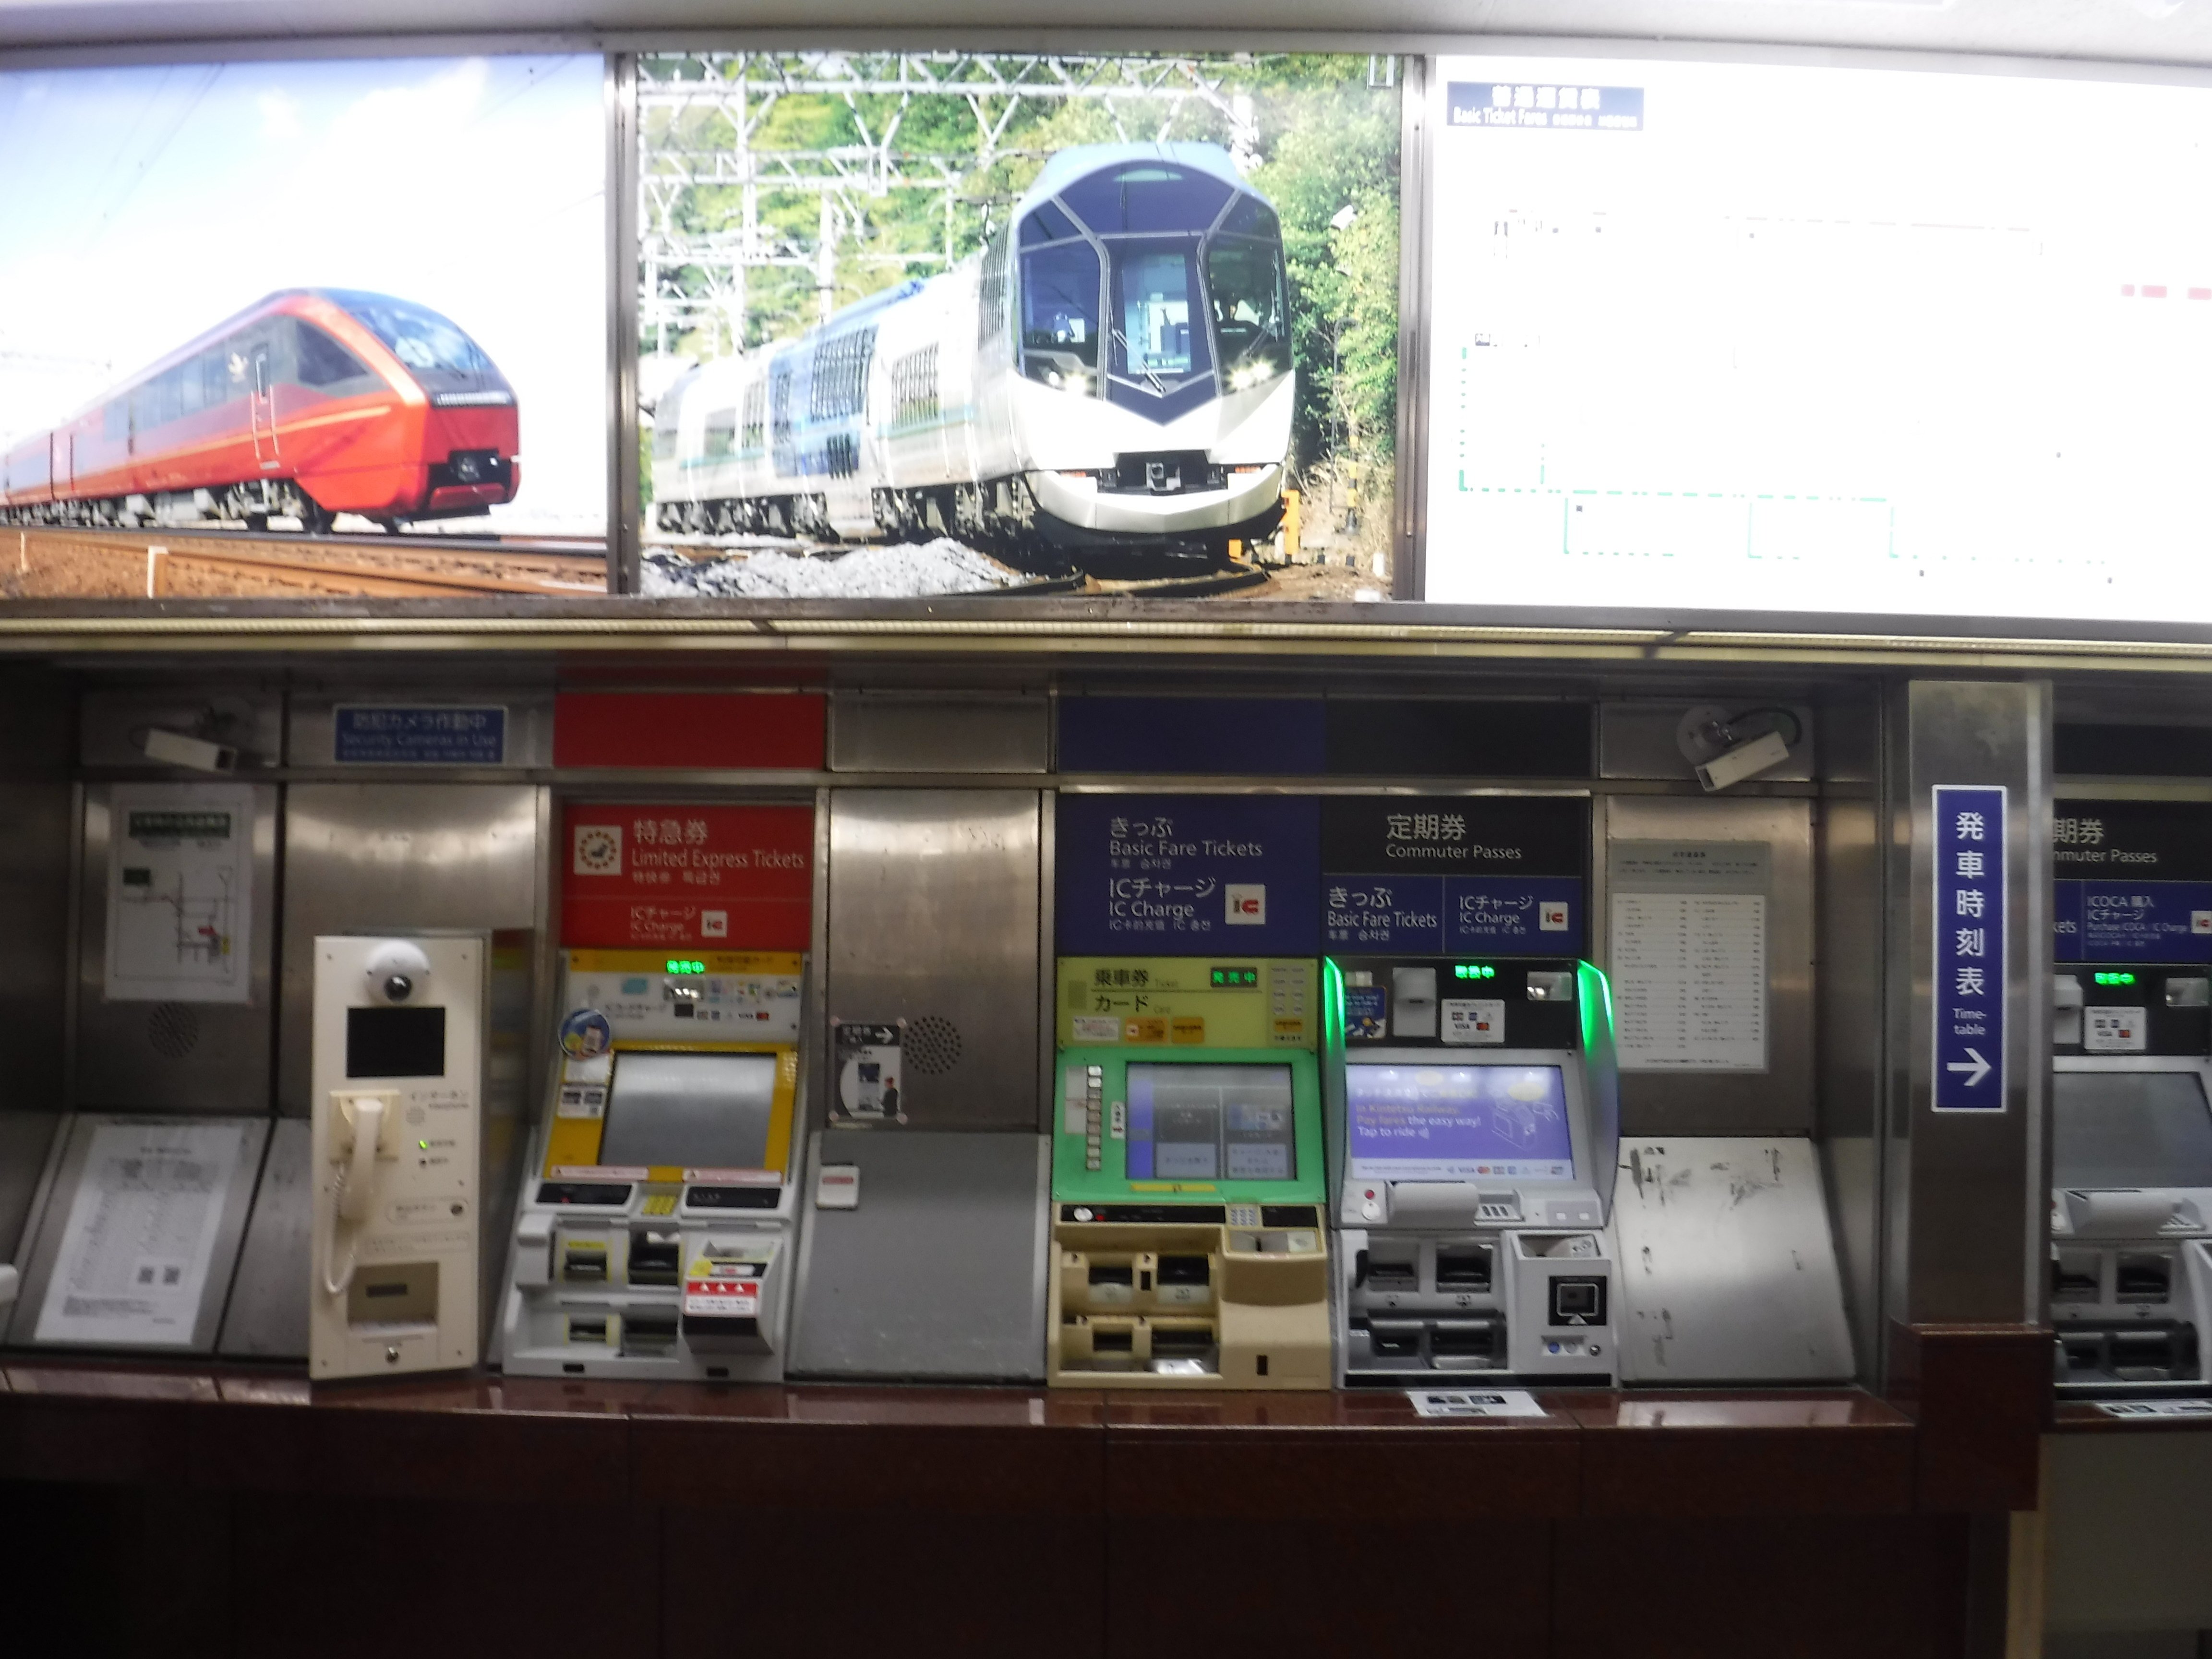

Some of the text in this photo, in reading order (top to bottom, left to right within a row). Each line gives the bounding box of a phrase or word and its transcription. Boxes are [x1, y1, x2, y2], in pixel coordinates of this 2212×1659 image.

[1110, 817, 1173, 838] きっぷ
[1387, 814, 1466, 841] 定期券
[2054, 818, 2104, 844] 期券
[1109, 840, 1262, 856] Basic Fare Tickets
[1386, 844, 1521, 859] Commuter Passes
[2054, 849, 2157, 863] mmuter Passes
[632, 848, 805, 871] Limited Express Tickets
[1109, 877, 1216, 898] ICチャージ
[1328, 887, 1392, 908] きっぷ
[1459, 895, 1533, 911] ICチャージ
[1956, 811, 1985, 996] 発車時刻表
[2087, 896, 2128, 907] ICOCA
[1109, 901, 1194, 921] IC Charge
[1327, 911, 1437, 928] Basic Fare Tickets
[1459, 912, 1520, 926] IC Charge
[1095, 995, 1149, 1012] カード
[1954, 1023, 1985, 1036] table
[1407, 1116, 1426, 1125] the
[1429, 1118, 1453, 1128] easy
[1358, 1127, 1415, 1138] Tap to ride
